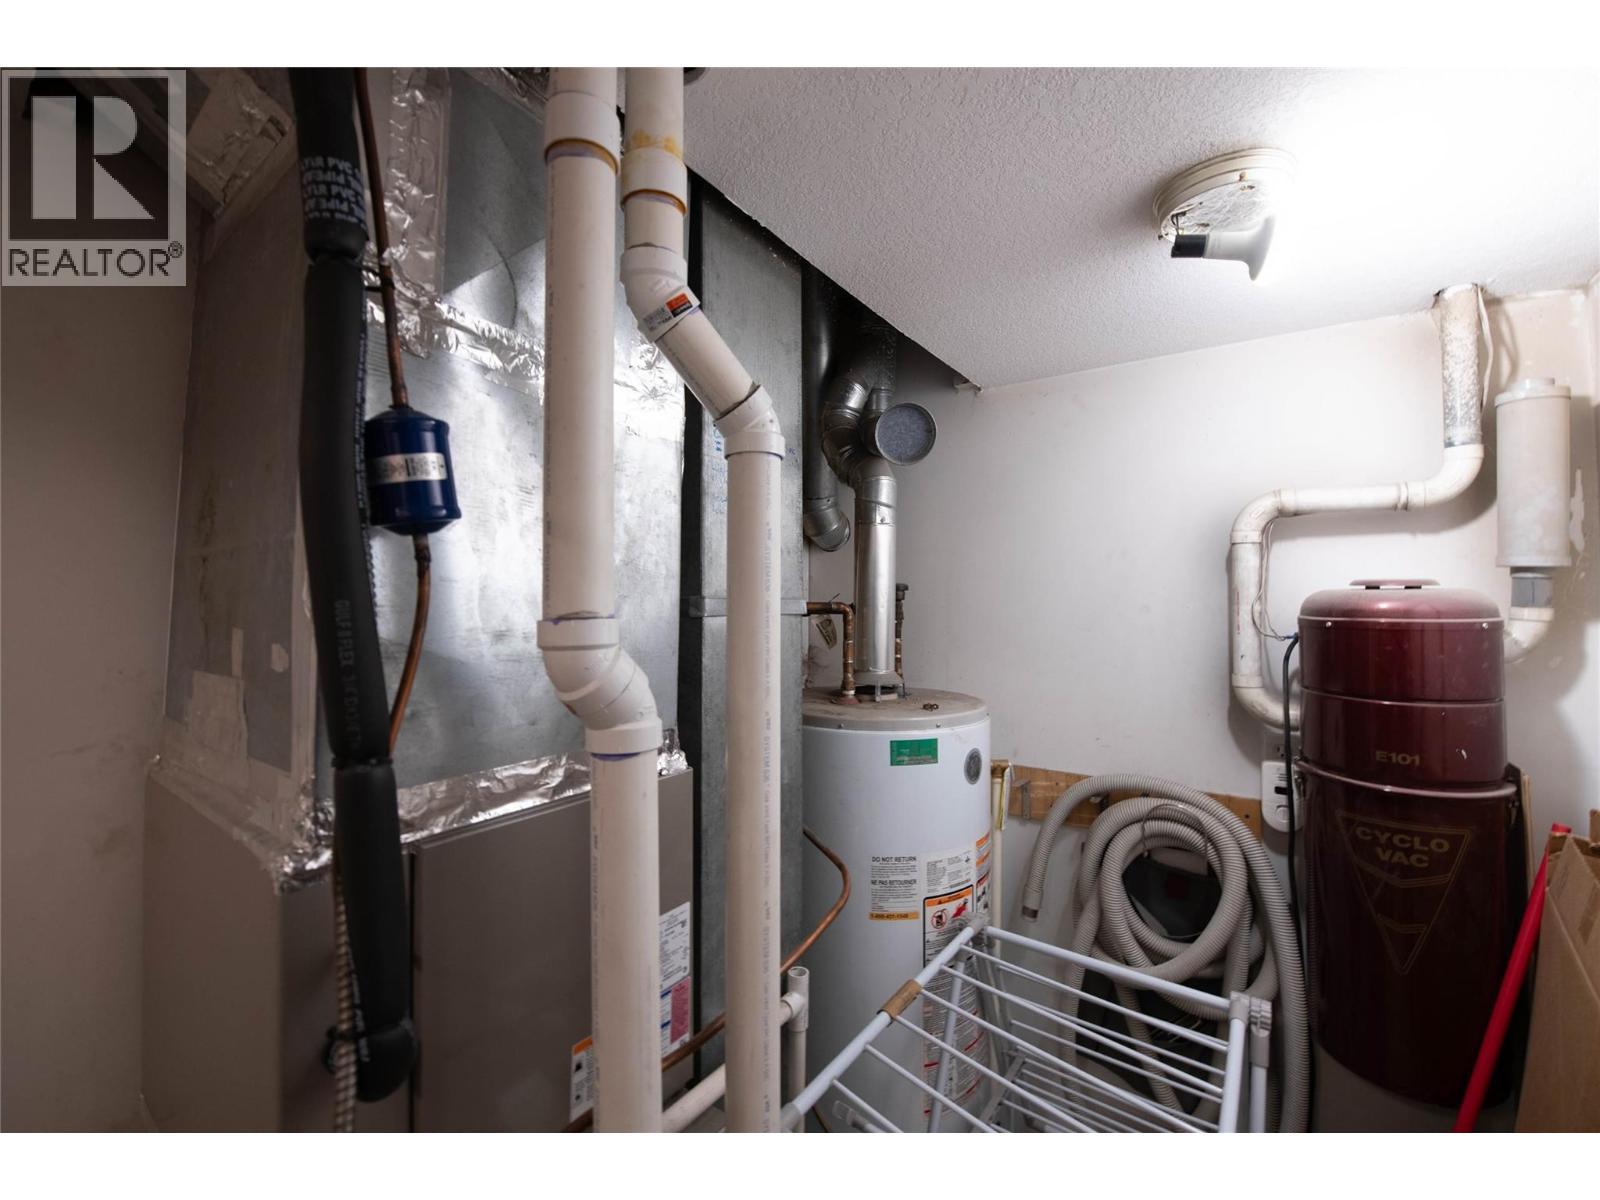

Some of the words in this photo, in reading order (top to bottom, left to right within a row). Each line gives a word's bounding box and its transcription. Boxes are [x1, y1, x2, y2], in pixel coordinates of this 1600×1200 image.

[1375, 750, 1420, 767] E101
[1356, 826, 1451, 853] CYCLO
[1375, 847, 1430, 868] VAC
